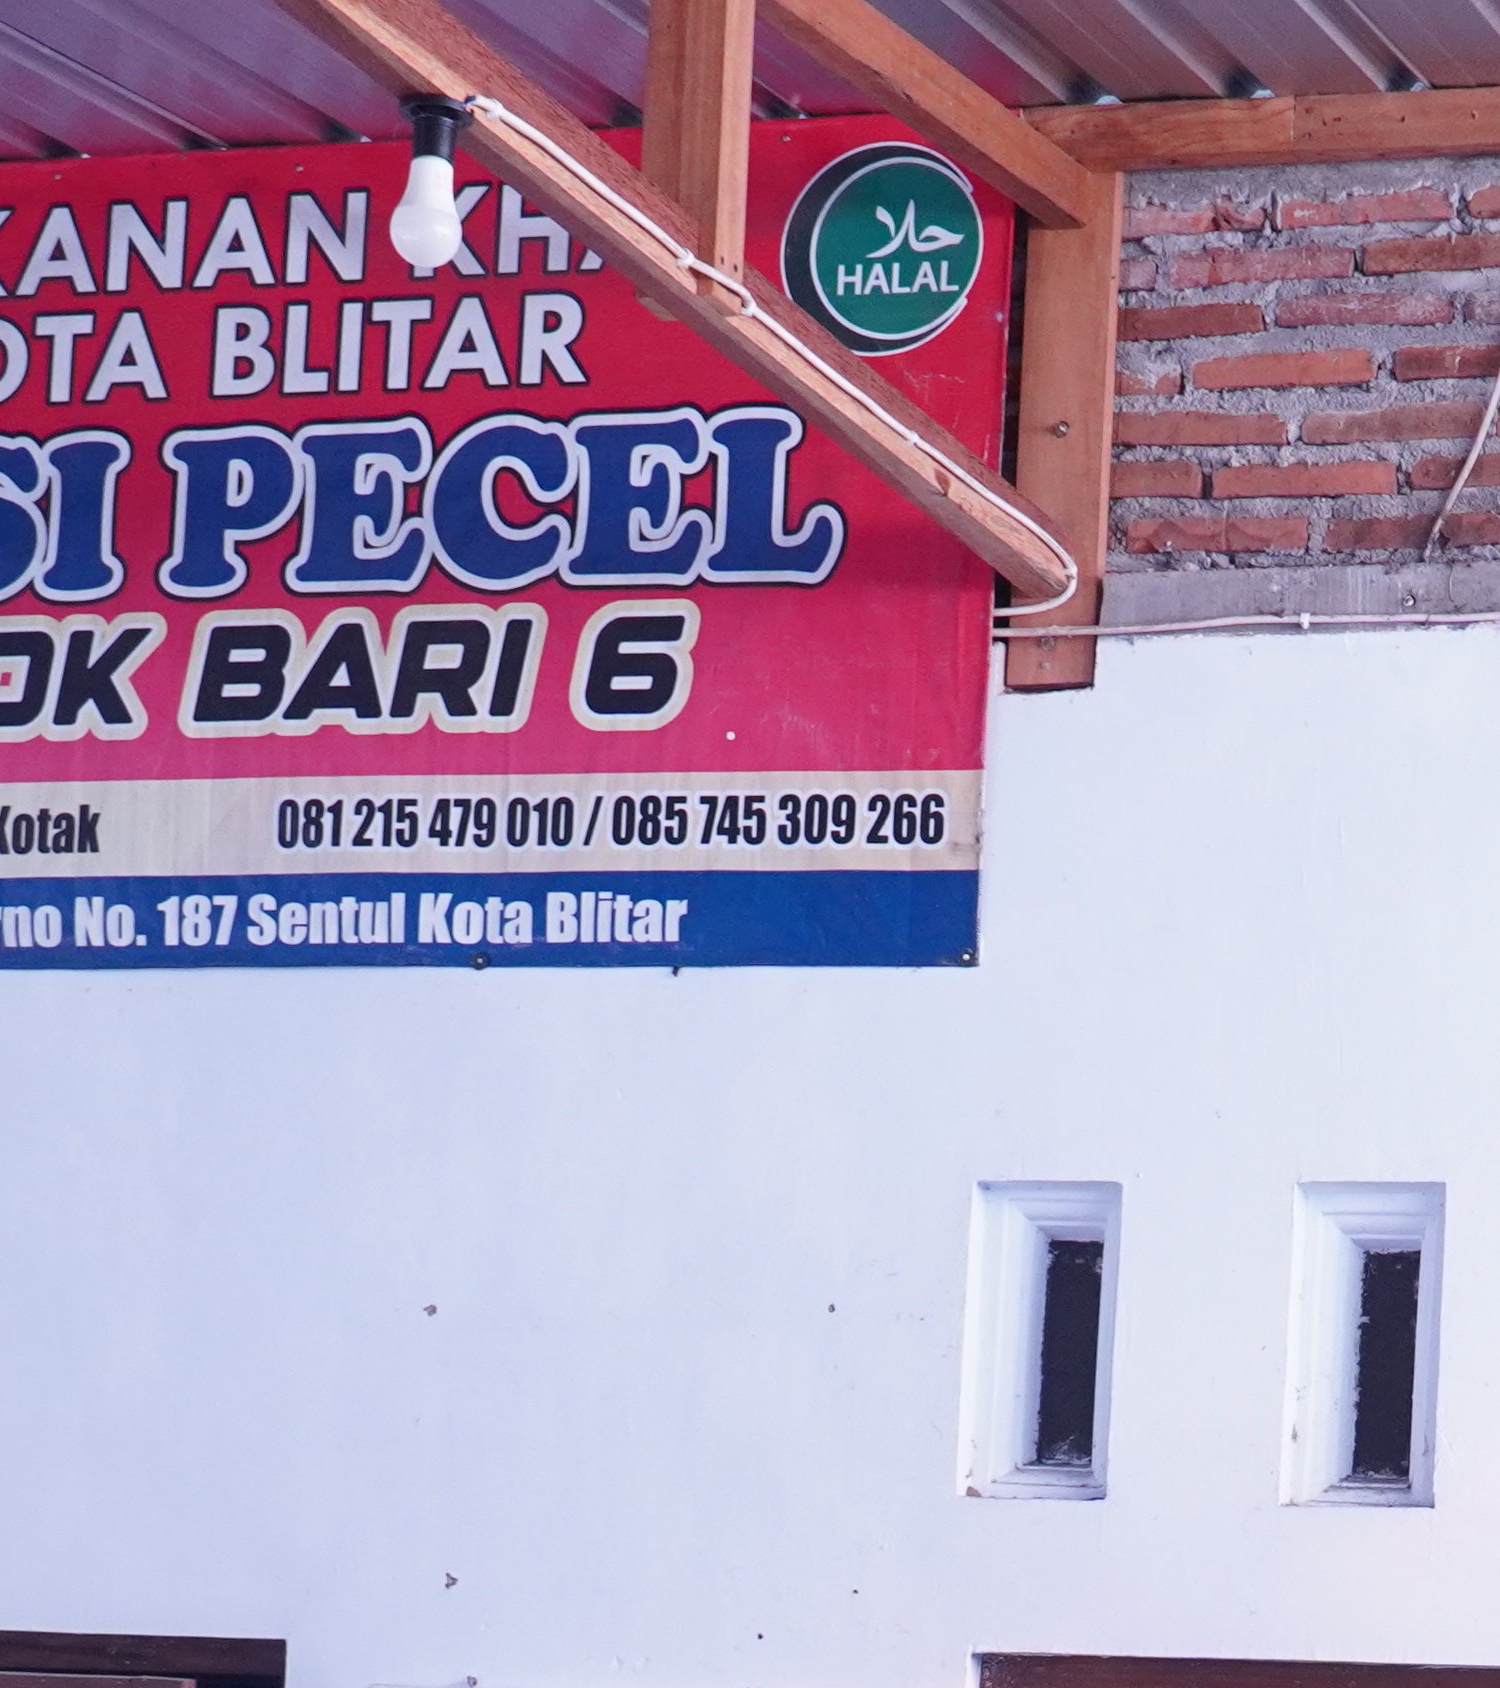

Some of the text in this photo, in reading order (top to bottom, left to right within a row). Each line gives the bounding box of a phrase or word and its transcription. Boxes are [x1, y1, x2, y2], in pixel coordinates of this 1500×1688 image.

[411, 182, 602, 279] KH
[837, 260, 960, 296] HALAL
[211, 292, 590, 398] BLITAR
[159, 410, 845, 597] PECEL
[191, 616, 534, 723] BARI
[583, 612, 685, 716] 6
[276, 793, 945, 848] 081 215 479 010 / 085 745 309 266
[73, 897, 147, 948] No.
[156, 895, 238, 945] 187
[246, 893, 405, 945] Sentul
[417, 891, 533, 944] Kota
[546, 890, 688, 943] Blitar
